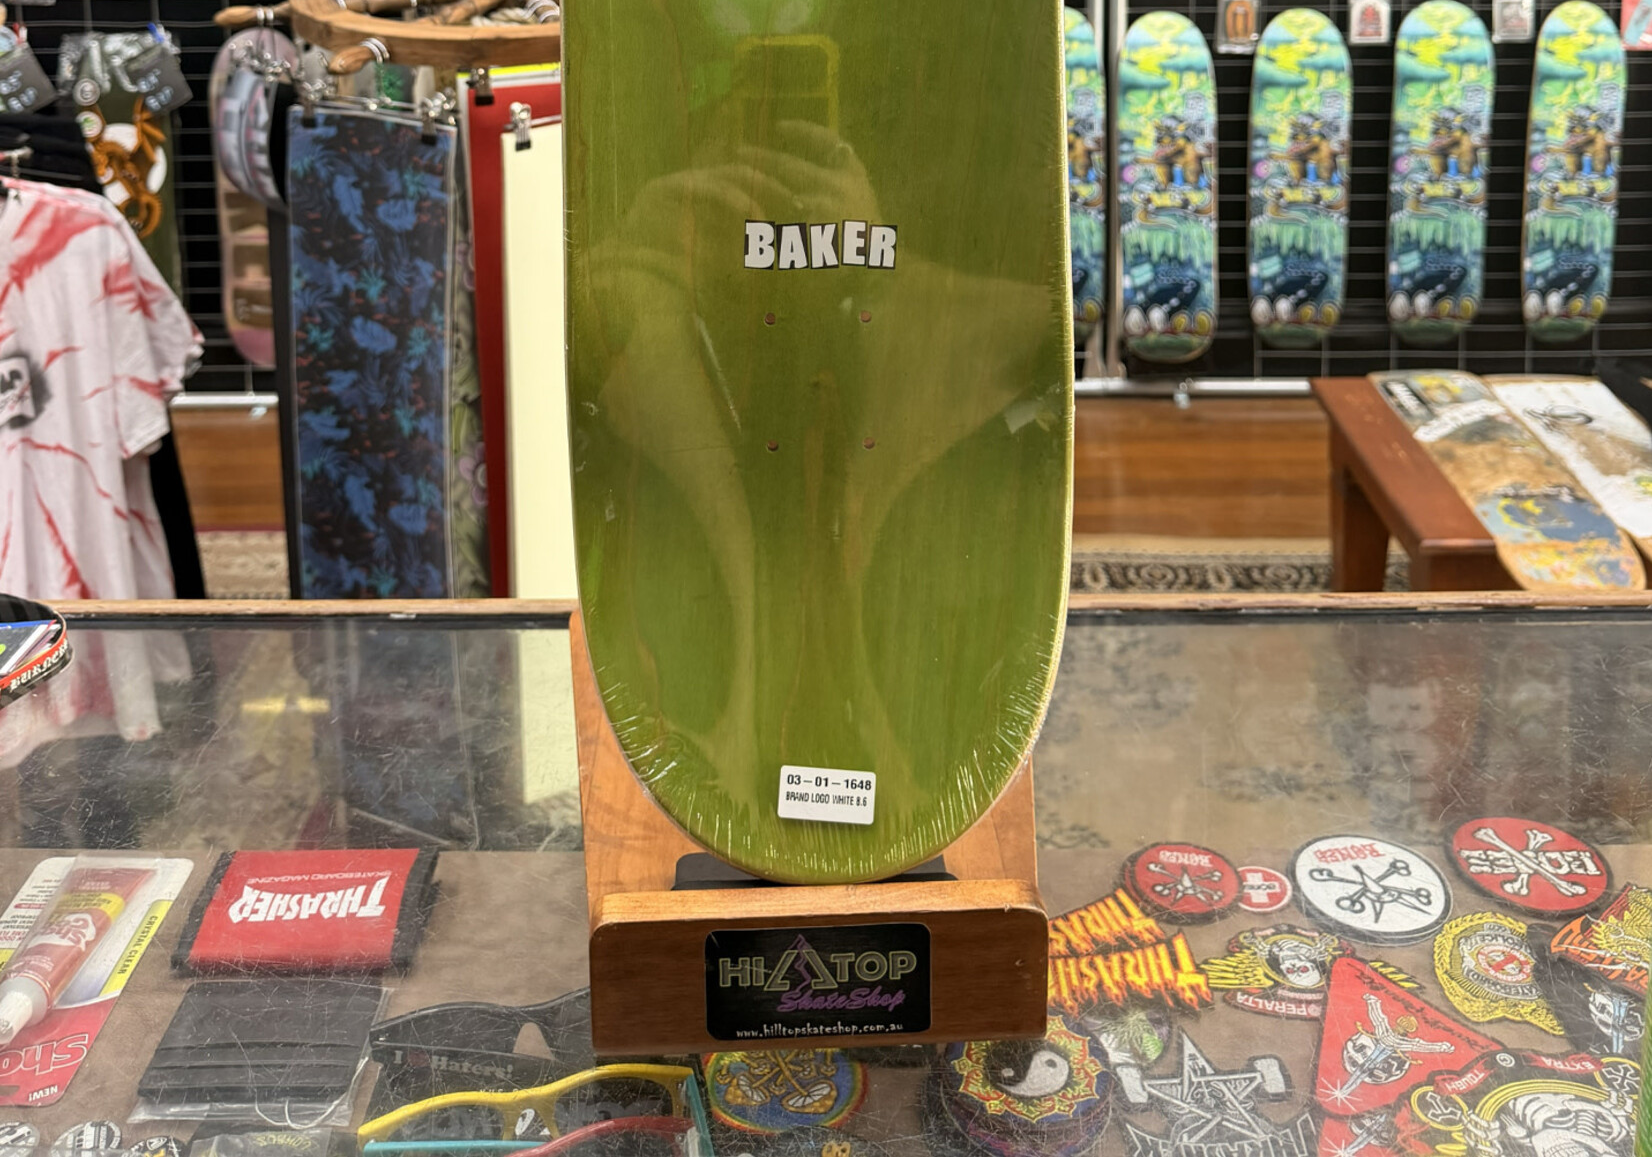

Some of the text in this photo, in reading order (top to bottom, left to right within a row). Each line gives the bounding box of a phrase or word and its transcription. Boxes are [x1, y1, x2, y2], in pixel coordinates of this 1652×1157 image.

[744, 220, 897, 270] BAKER
[785, 790, 810, 802] BRAND
[811, 792, 830, 804] LOGO
[832, 794, 854, 806] WHITE
[246, 870, 392, 884] SKATEBOARD MAGAZINE
[228, 875, 390, 924] THRASHER
[1049, 887, 1165, 956] THRAS
[116, 915, 159, 975] CRYSTAL CLEAR
[1049, 932, 1213, 1017] THRASH
[1236, 991, 1307, 1015] PERALTA
[736, 1021, 904, 1038] www.hilltopskateshop.com.au
[0, 1033, 88, 1076] Sho
[431, 1054, 514, 1079] Haters!
[1540, 1055, 1596, 1072] EXTRA
[28, 1084, 58, 1102] NEW!
[1444, 1069, 1486, 1094] TOUGH
